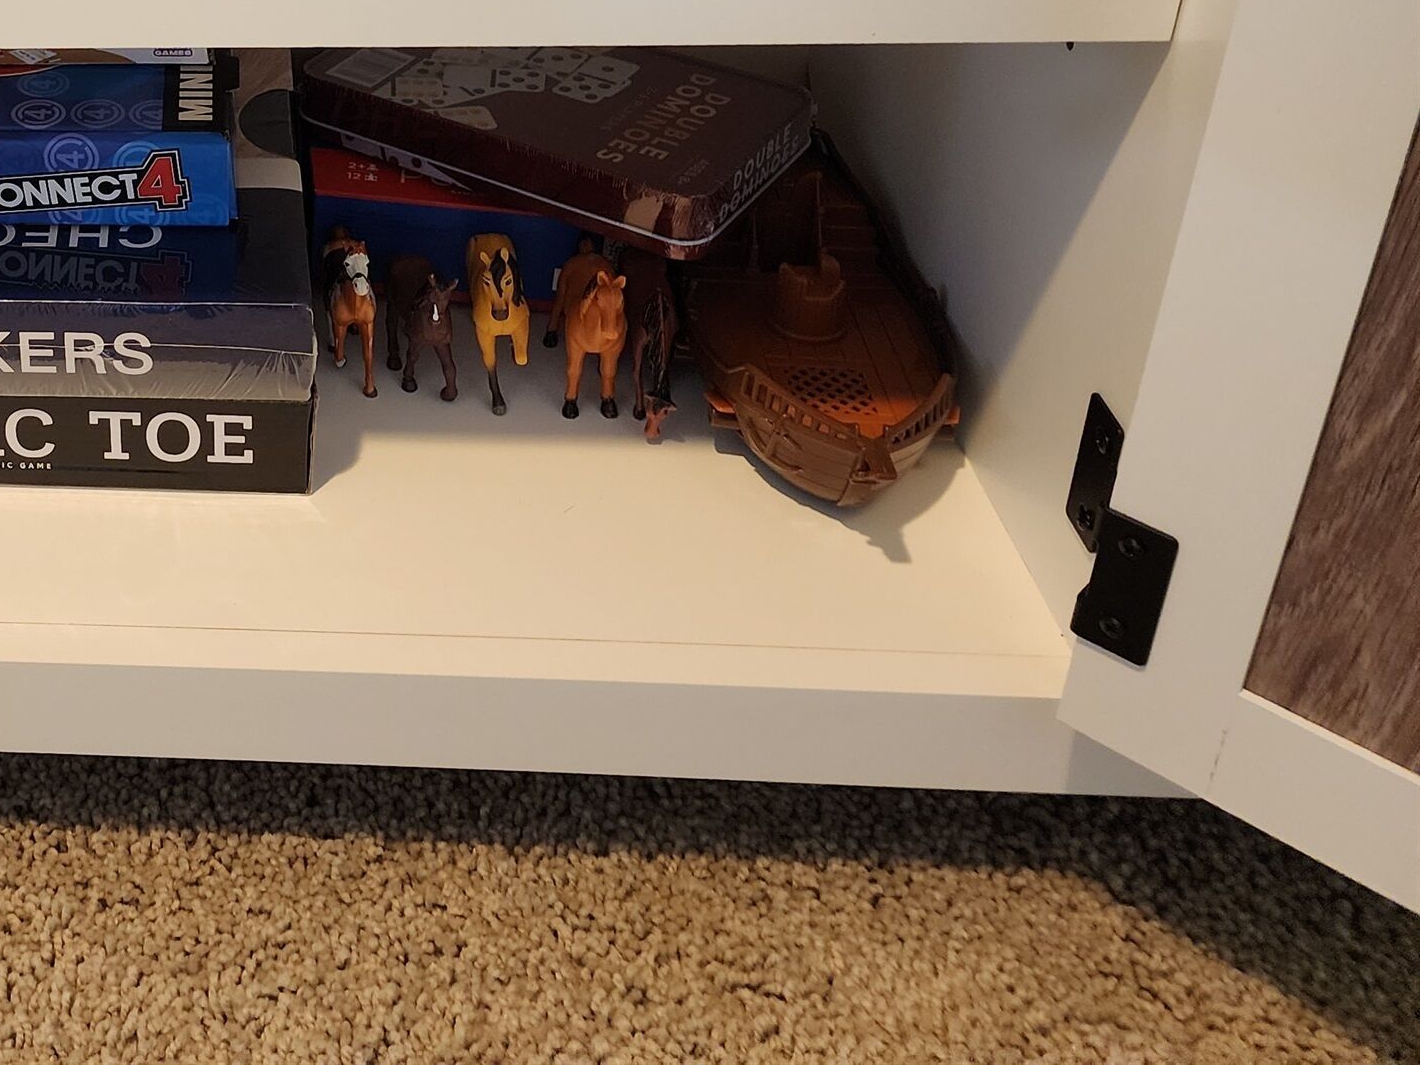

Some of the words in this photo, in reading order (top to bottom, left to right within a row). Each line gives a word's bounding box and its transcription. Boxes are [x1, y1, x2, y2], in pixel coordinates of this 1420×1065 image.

[154, 49, 192, 57] GAMES
[178, 64, 214, 122] MINI
[595, 73, 717, 164] DOMINOES
[638, 92, 732, 161] DOUBLE
[136, 151, 184, 207] 4
[733, 121, 793, 191] DOUBLE
[19, 462, 53, 471] GAME
[88, 410, 256, 467] TOE
